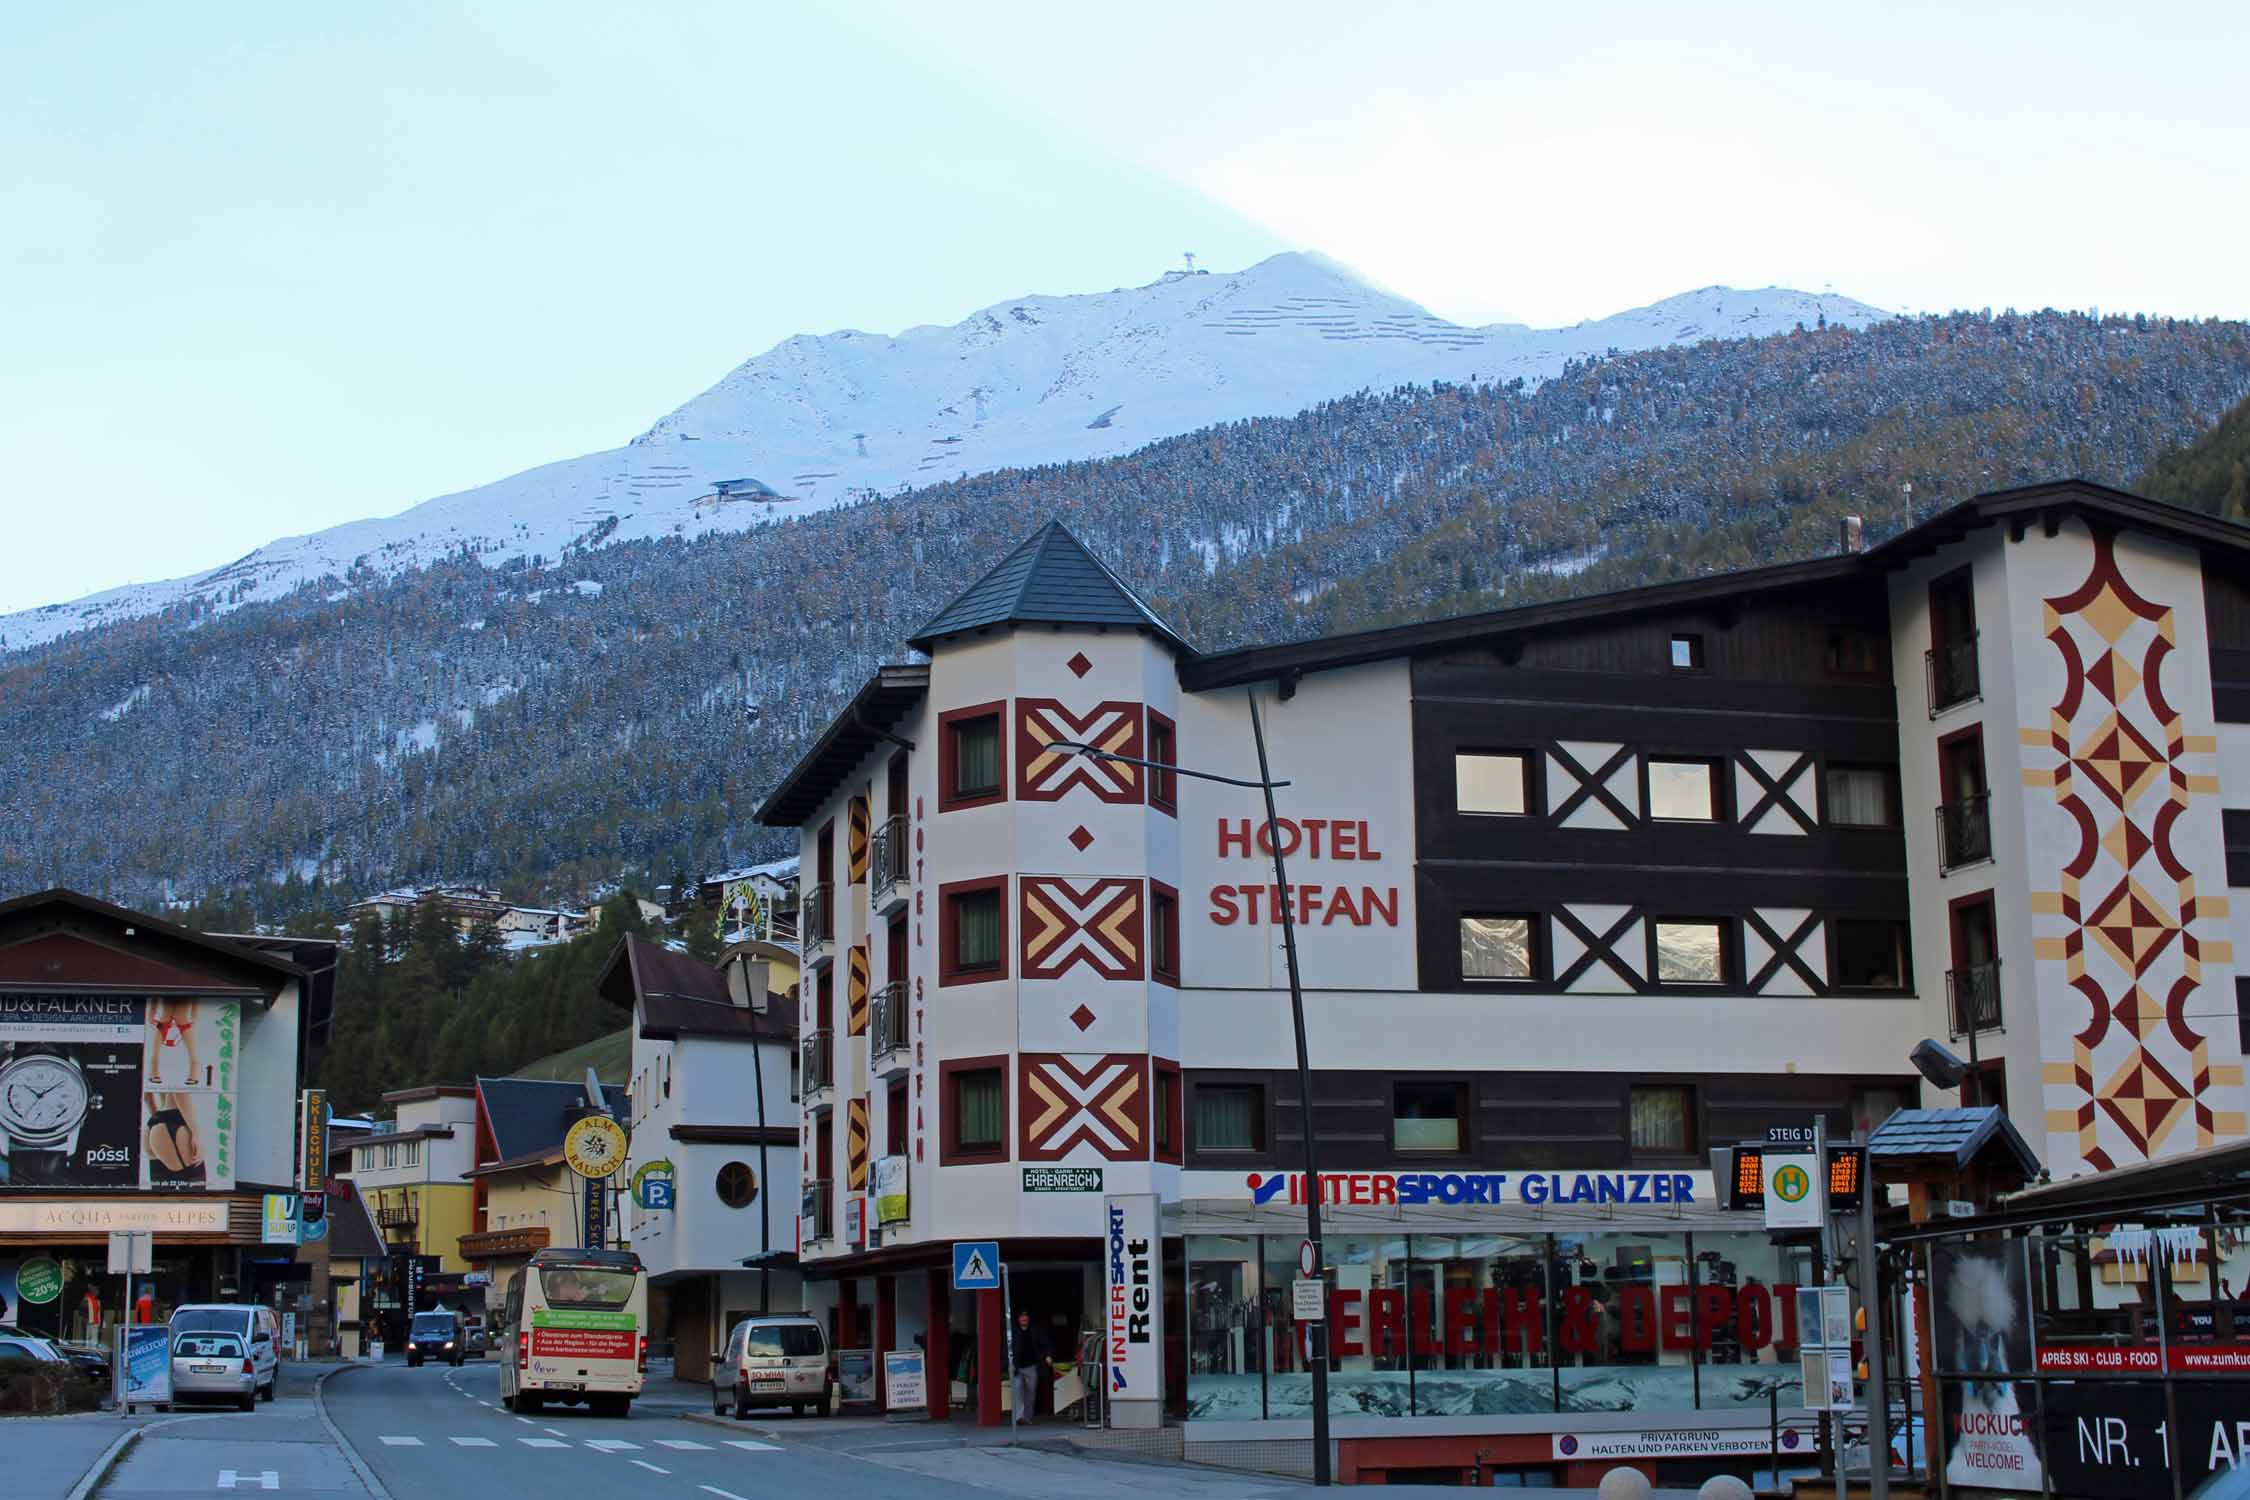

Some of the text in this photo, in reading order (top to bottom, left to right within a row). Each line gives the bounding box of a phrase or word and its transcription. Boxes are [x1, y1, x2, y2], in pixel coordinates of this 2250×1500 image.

[1218, 817, 1381, 861] HOTEL
[1209, 884, 1398, 927] STEFAN
[584, 1119, 613, 1132] ALM
[1769, 1128, 1813, 1141] STEIG D
[309, 1095, 320, 1187] SKISCHULE
[569, 1154, 620, 1176] RAUSCH
[1025, 1174, 1092, 1187] EHRENREICH
[1288, 1174, 1696, 1205] INTERSPORT GLANZER
[650, 1185, 665, 1204] P
[45, 1210, 113, 1225] ACQUA
[167, 1210, 217, 1224] ALPES
[1109, 1205, 1127, 1362] INTERSPORT
[1127, 1239, 1150, 1343] Rent
[1295, 1287, 1543, 1357] ERLEIH
[1560, 1286, 1600, 1356] &
[1619, 1284, 1798, 1353] DEPOT
[2073, 1352, 2089, 1365] SKI
[2096, 1352, 2122, 1365] CLUB
[2130, 1352, 2158, 1365] FOOD
[1952, 1412, 2033, 1436] KUCKUCK
[1591, 1440, 1770, 1455] HALTEN UND PARKEN VERBOTEN
[1640, 1431, 1720, 1442] PRIVATGRUND
[2077, 1416, 2140, 1467] NR.
[2154, 1420, 2170, 1469] 1
[1964, 1452, 2025, 1471] WELCOME!
